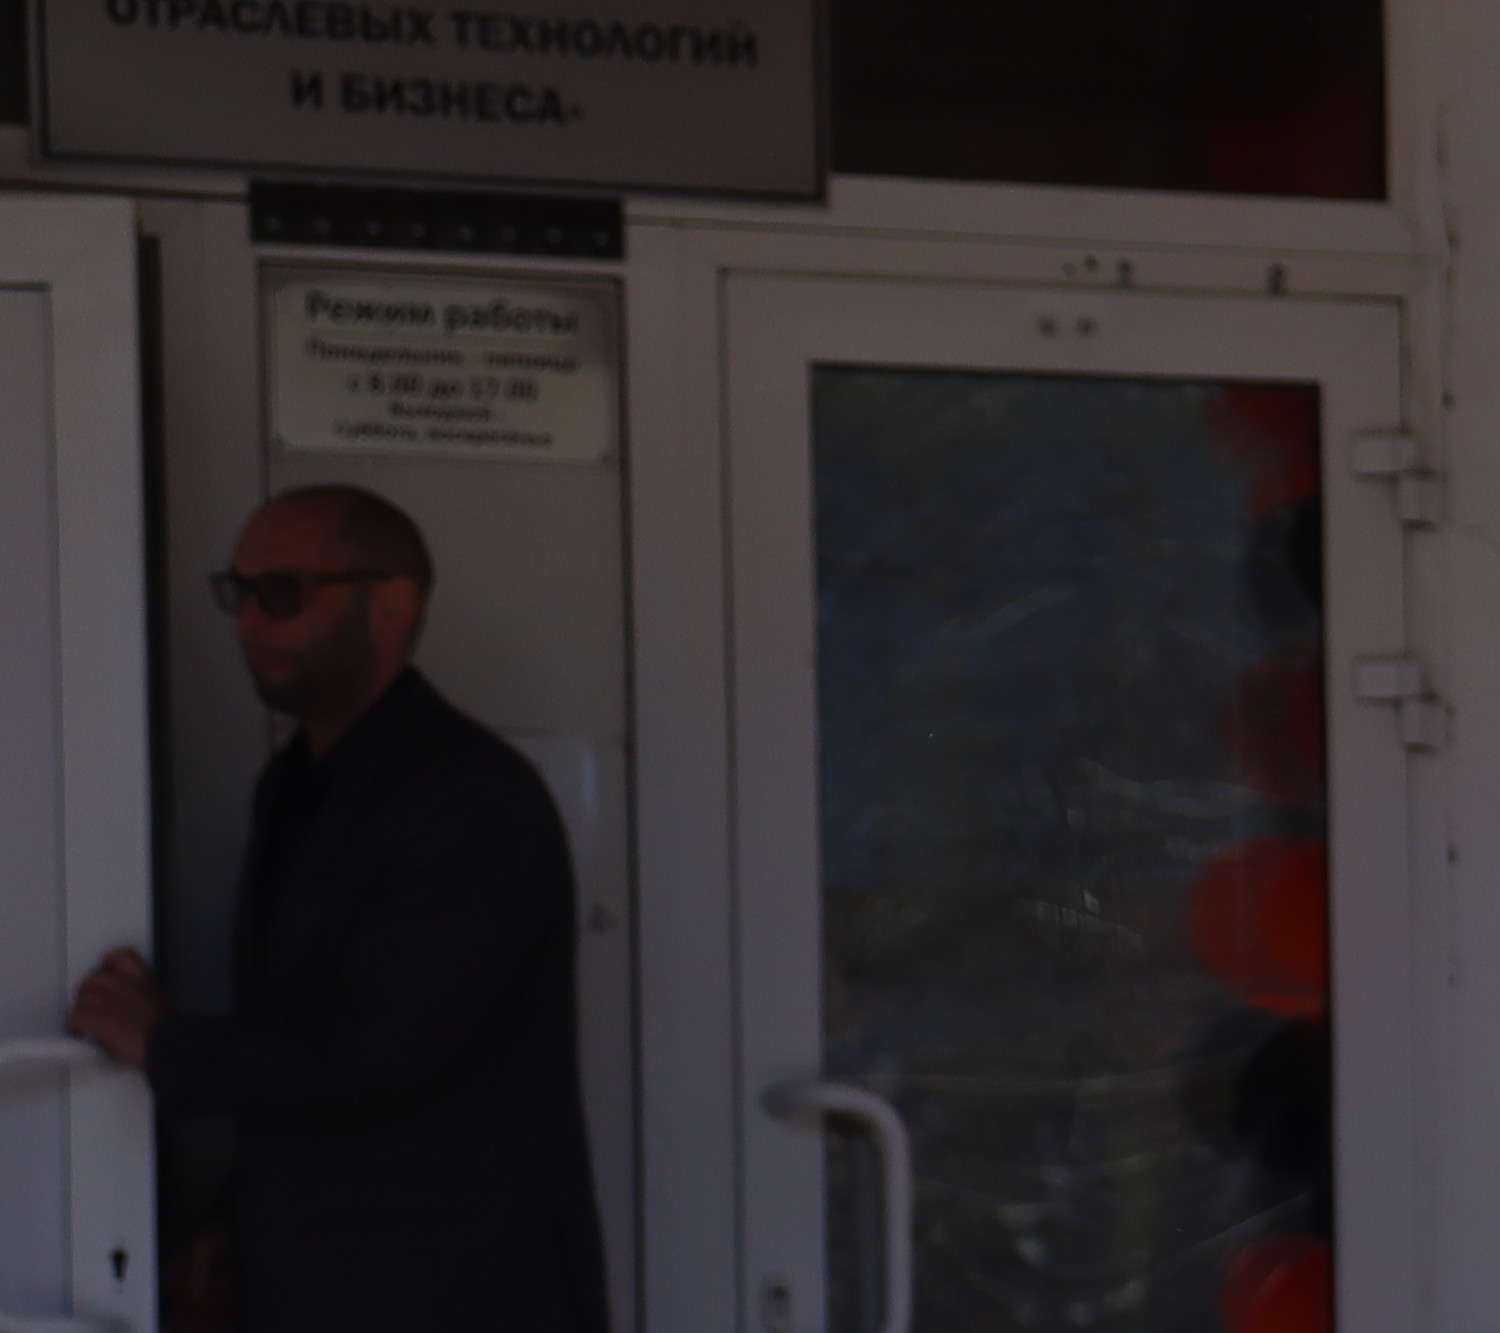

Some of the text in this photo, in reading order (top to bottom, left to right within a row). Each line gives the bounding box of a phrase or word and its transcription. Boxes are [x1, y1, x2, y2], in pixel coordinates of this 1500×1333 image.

[105, 0, 760, 69] ОТРАСЛЕВЫХ ТЕХНОЛОГИЙ
[289, 69, 324, 111] И
[304, 289, 580, 333] Режим работы
